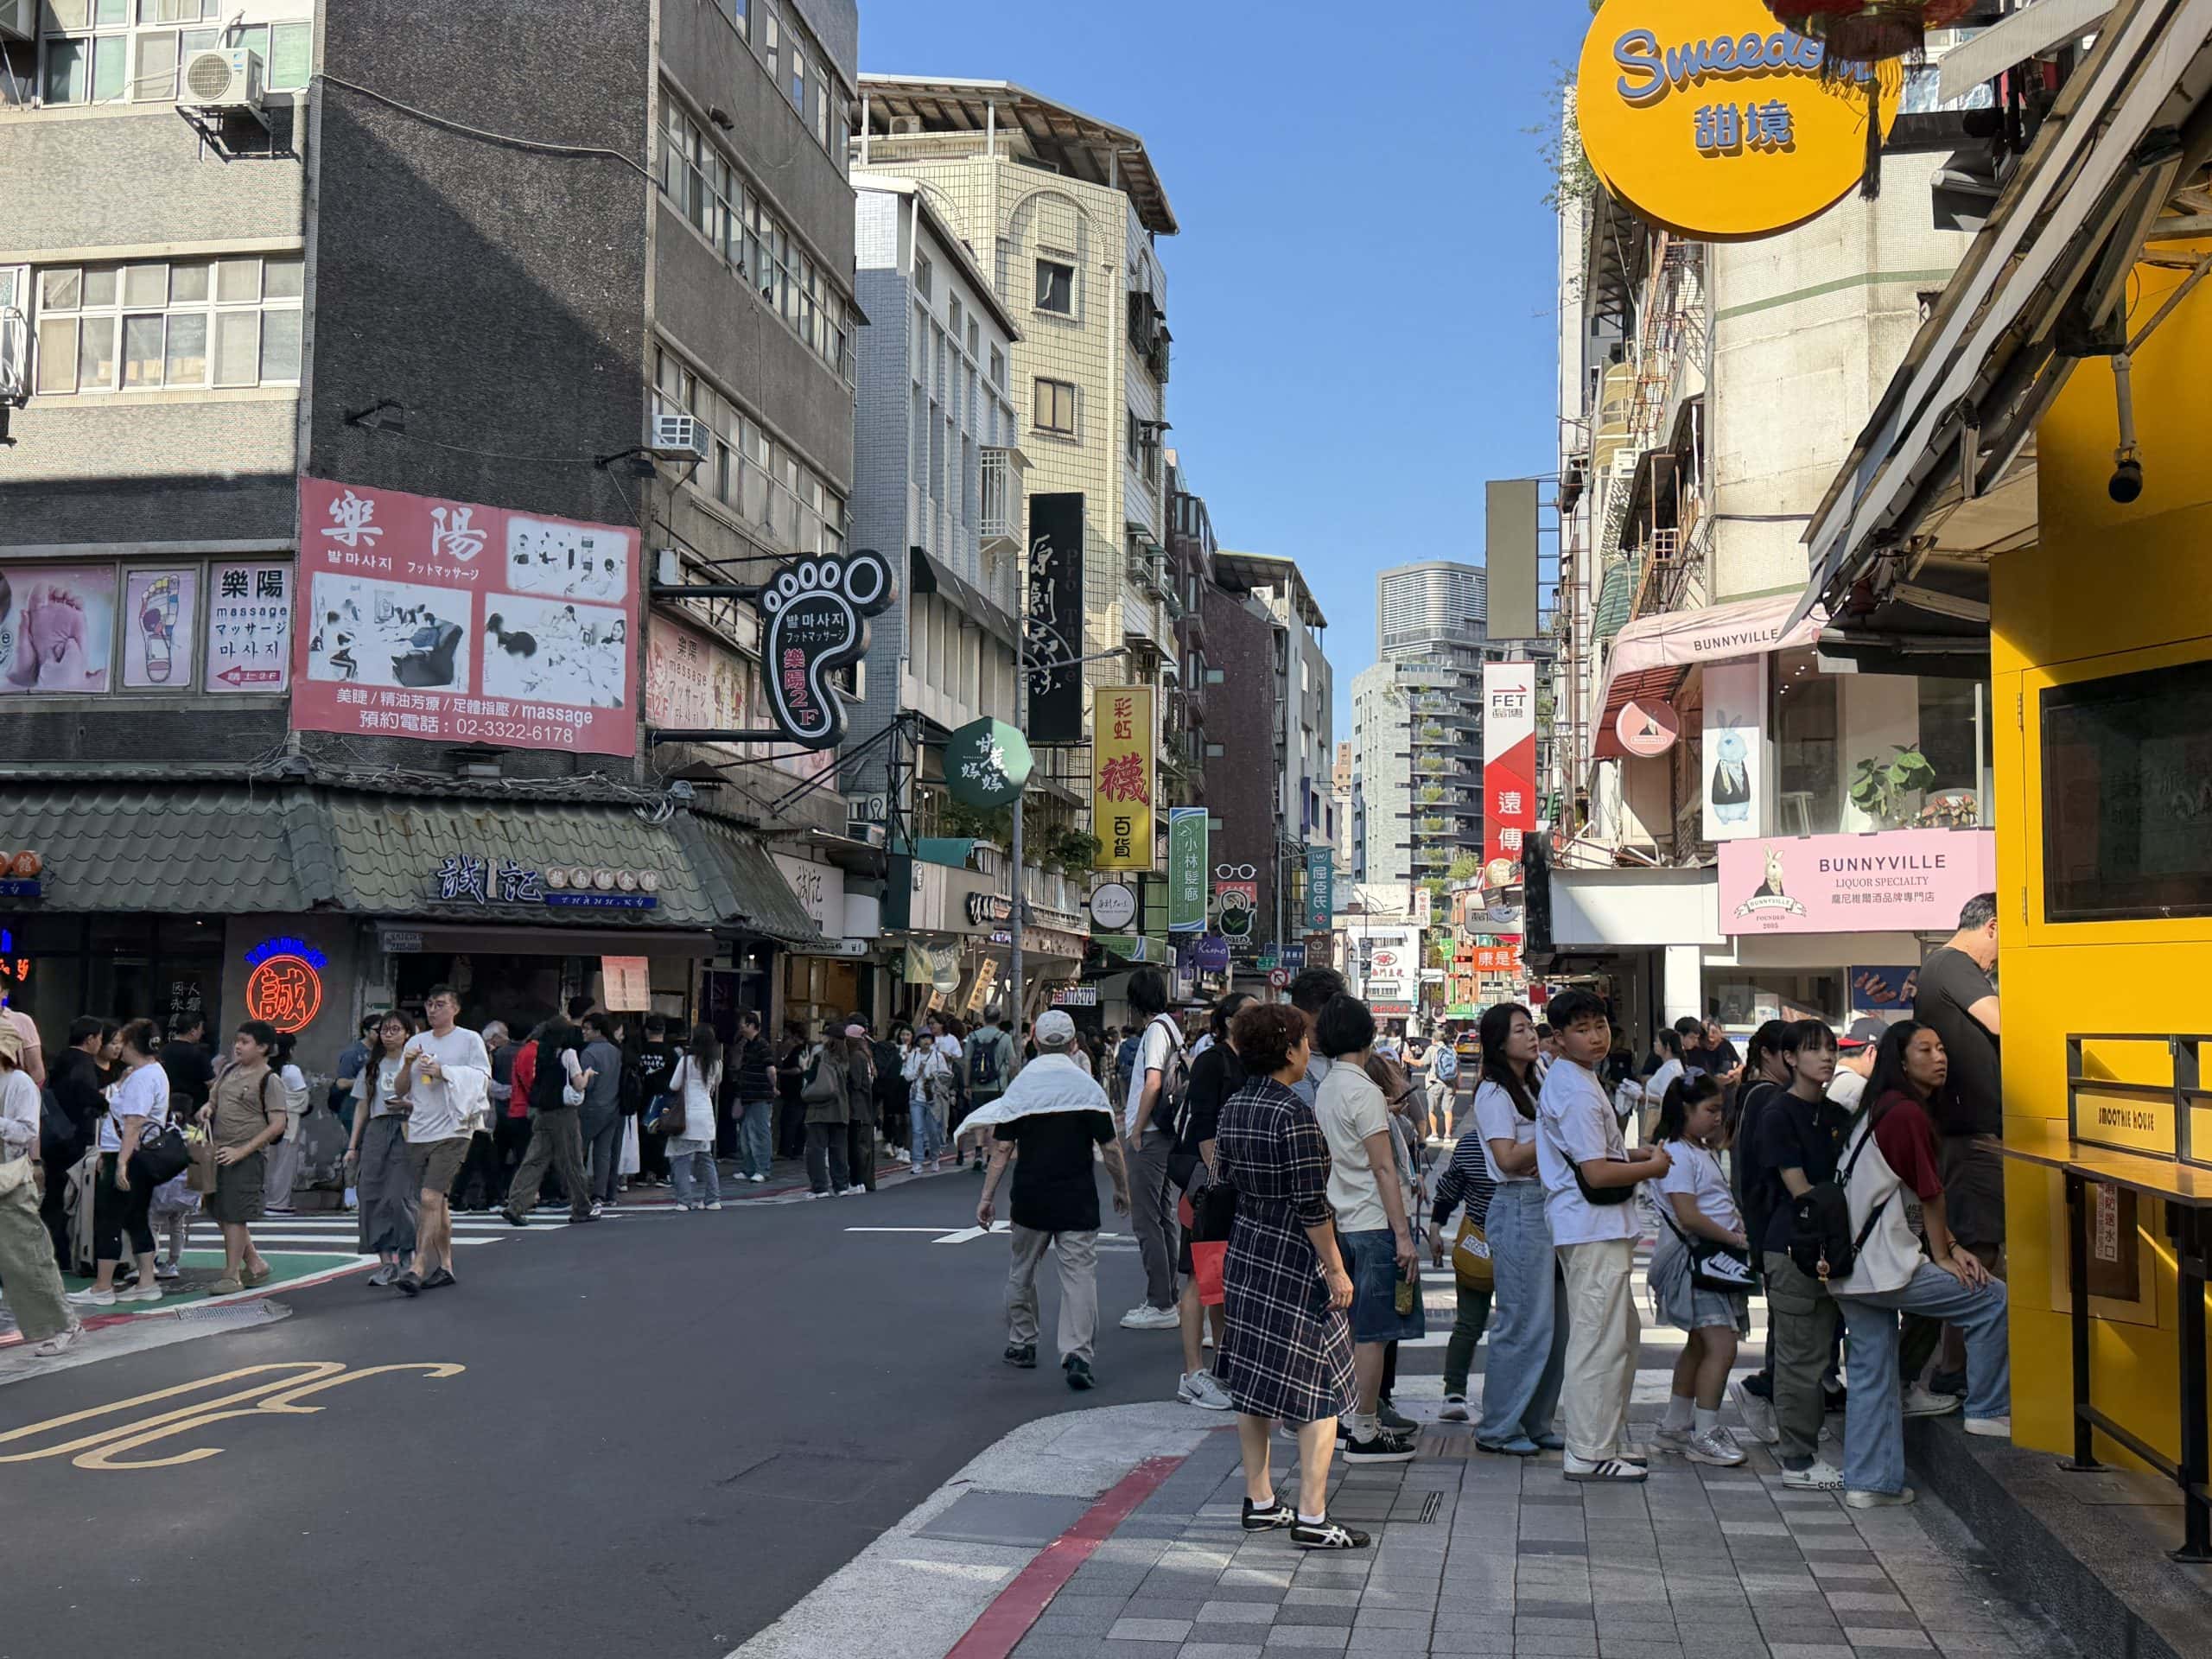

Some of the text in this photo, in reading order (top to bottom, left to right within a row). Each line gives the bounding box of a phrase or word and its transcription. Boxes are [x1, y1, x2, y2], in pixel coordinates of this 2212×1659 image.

[1694, 99, 1792, 149] 甜境
[321, 489, 488, 562] 樂陽
[221, 570, 284, 598] 樂陽
[407, 562, 480, 581] フットマッサージ
[216, 607, 288, 618] massage
[216, 621, 288, 636] マッサージ
[1694, 628, 1778, 651] BUNNYVILLE
[219, 641, 279, 660] 마사지
[336, 688, 368, 705] 美睫
[380, 690, 440, 711] 精油芳療
[452, 697, 510, 718] 足體指壓
[522, 704, 594, 728] massage
[1492, 695, 1528, 707] FET
[456, 718, 574, 743] 02-3322-6178
[1097, 697, 1150, 858] 彩虹 襪 百貨
[1497, 791, 1522, 851] 遠傳
[1184, 836, 1199, 901] 小林髮廊
[1820, 855, 1946, 872] BUNNYVILLE
[1313, 866, 1328, 909] 屈臣氏
[1836, 876, 1929, 890] LIQUOR SPECIALTY
[259, 967, 306, 1020] 誠
[1817, 1480, 1844, 1489] croc
